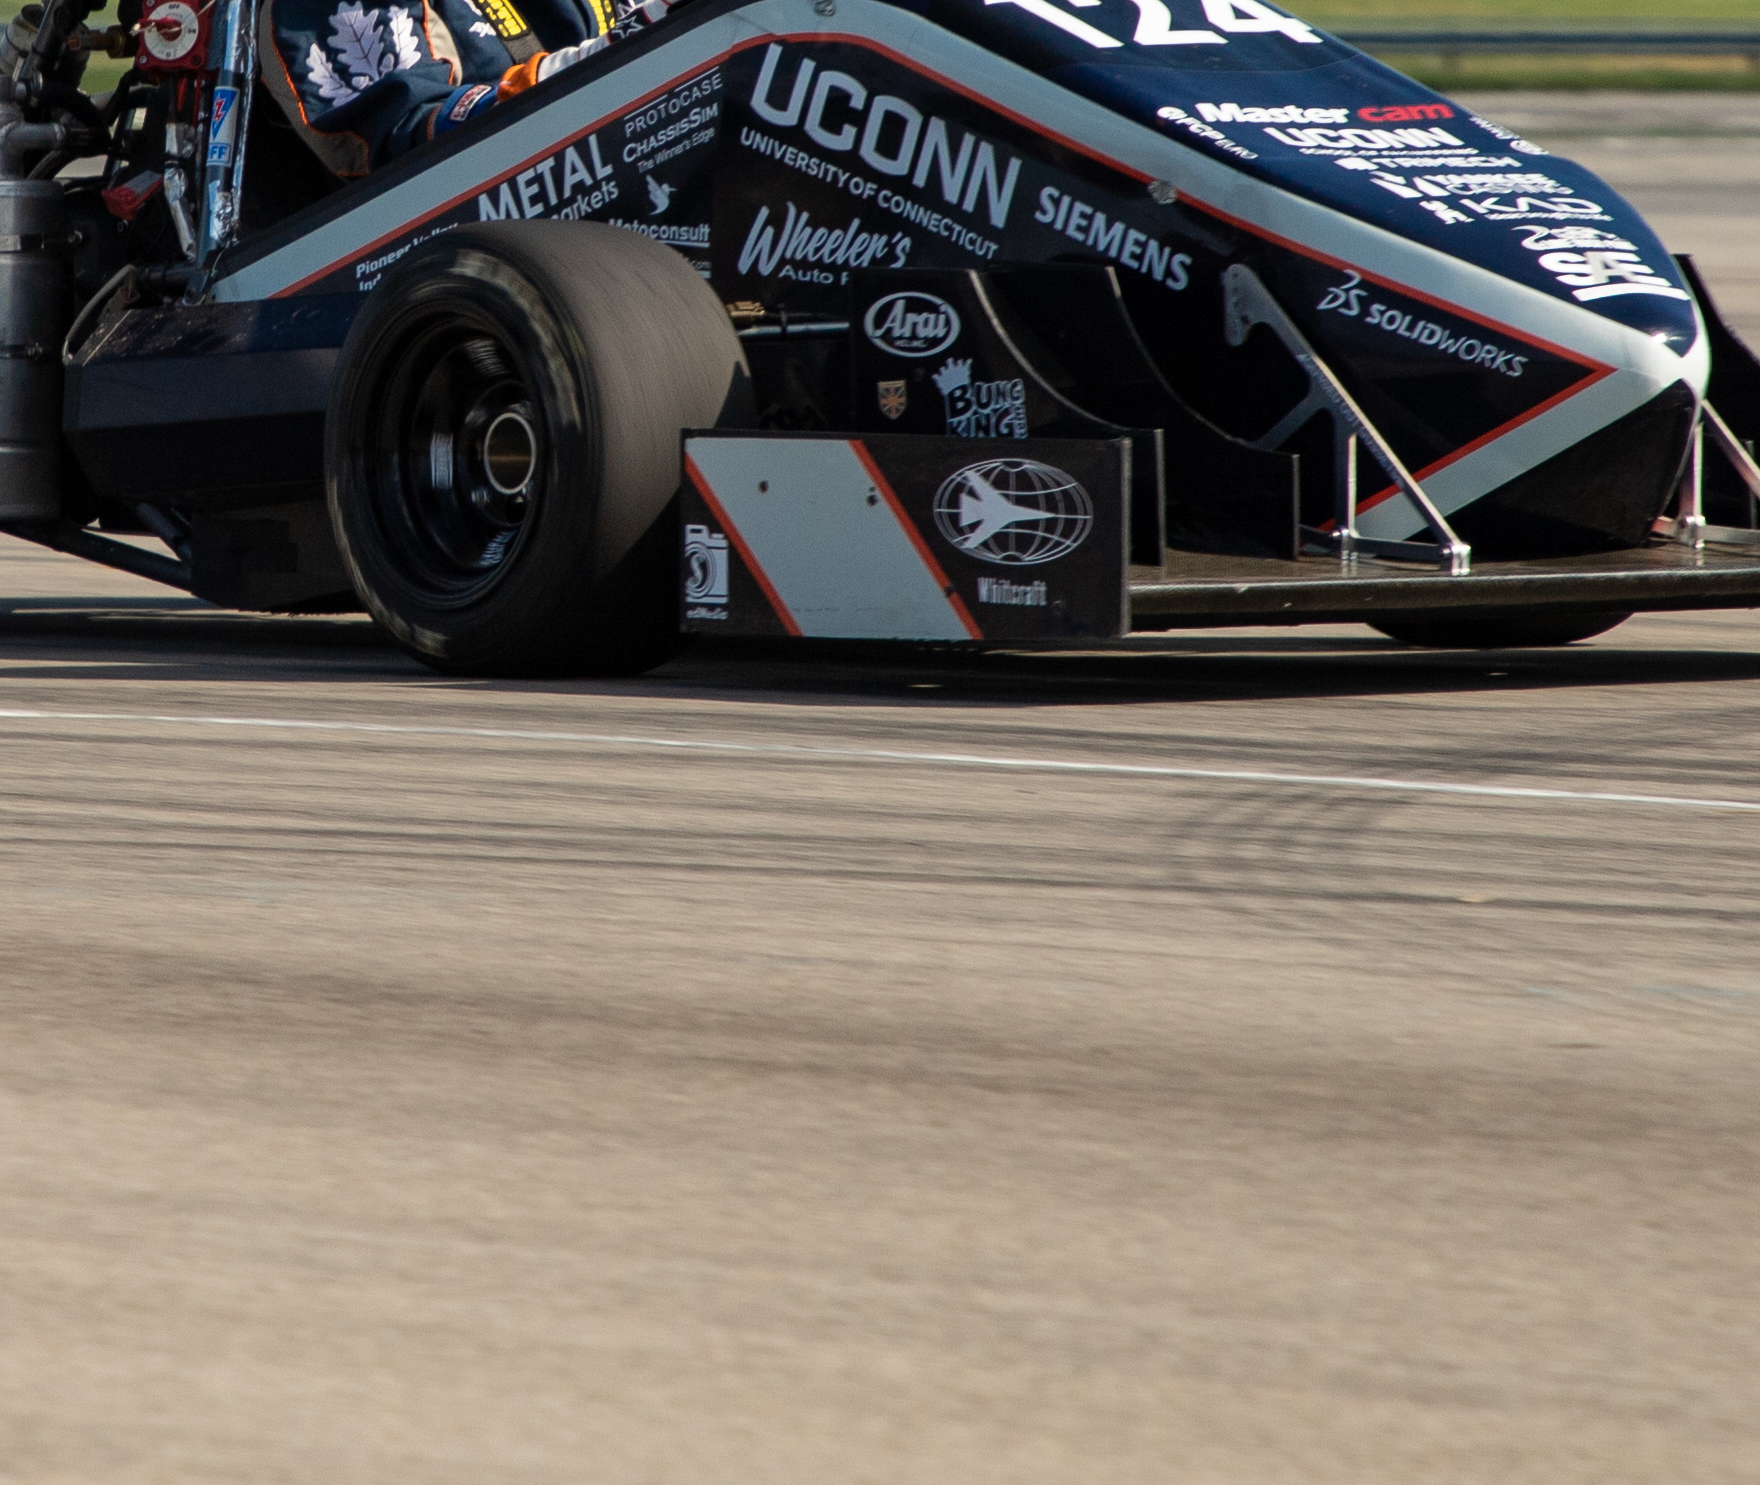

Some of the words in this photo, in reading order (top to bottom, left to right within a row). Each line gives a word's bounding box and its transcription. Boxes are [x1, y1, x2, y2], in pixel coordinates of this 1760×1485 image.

[625, 72, 723, 138] PROTOCASE
[750, 44, 1022, 228] UCONN
[1263, 127, 1465, 149] UCONN
[209, 145, 228, 160] FF
[478, 133, 613, 222] METAL
[741, 126, 849, 193] UNIVERSITY
[849, 176, 879, 201] OF
[877, 189, 999, 260] CONNECTICUT
[356, 243, 412, 279] Pioneer
[738, 201, 912, 276] Wheeler's
[1035, 186, 1193, 292] SIEMENS
[1538, 251, 1673, 286] SAE
[778, 265, 835, 284] Auto
[871, 299, 949, 339] Arai
[1364, 303, 1530, 378] SOLIDWORKS
